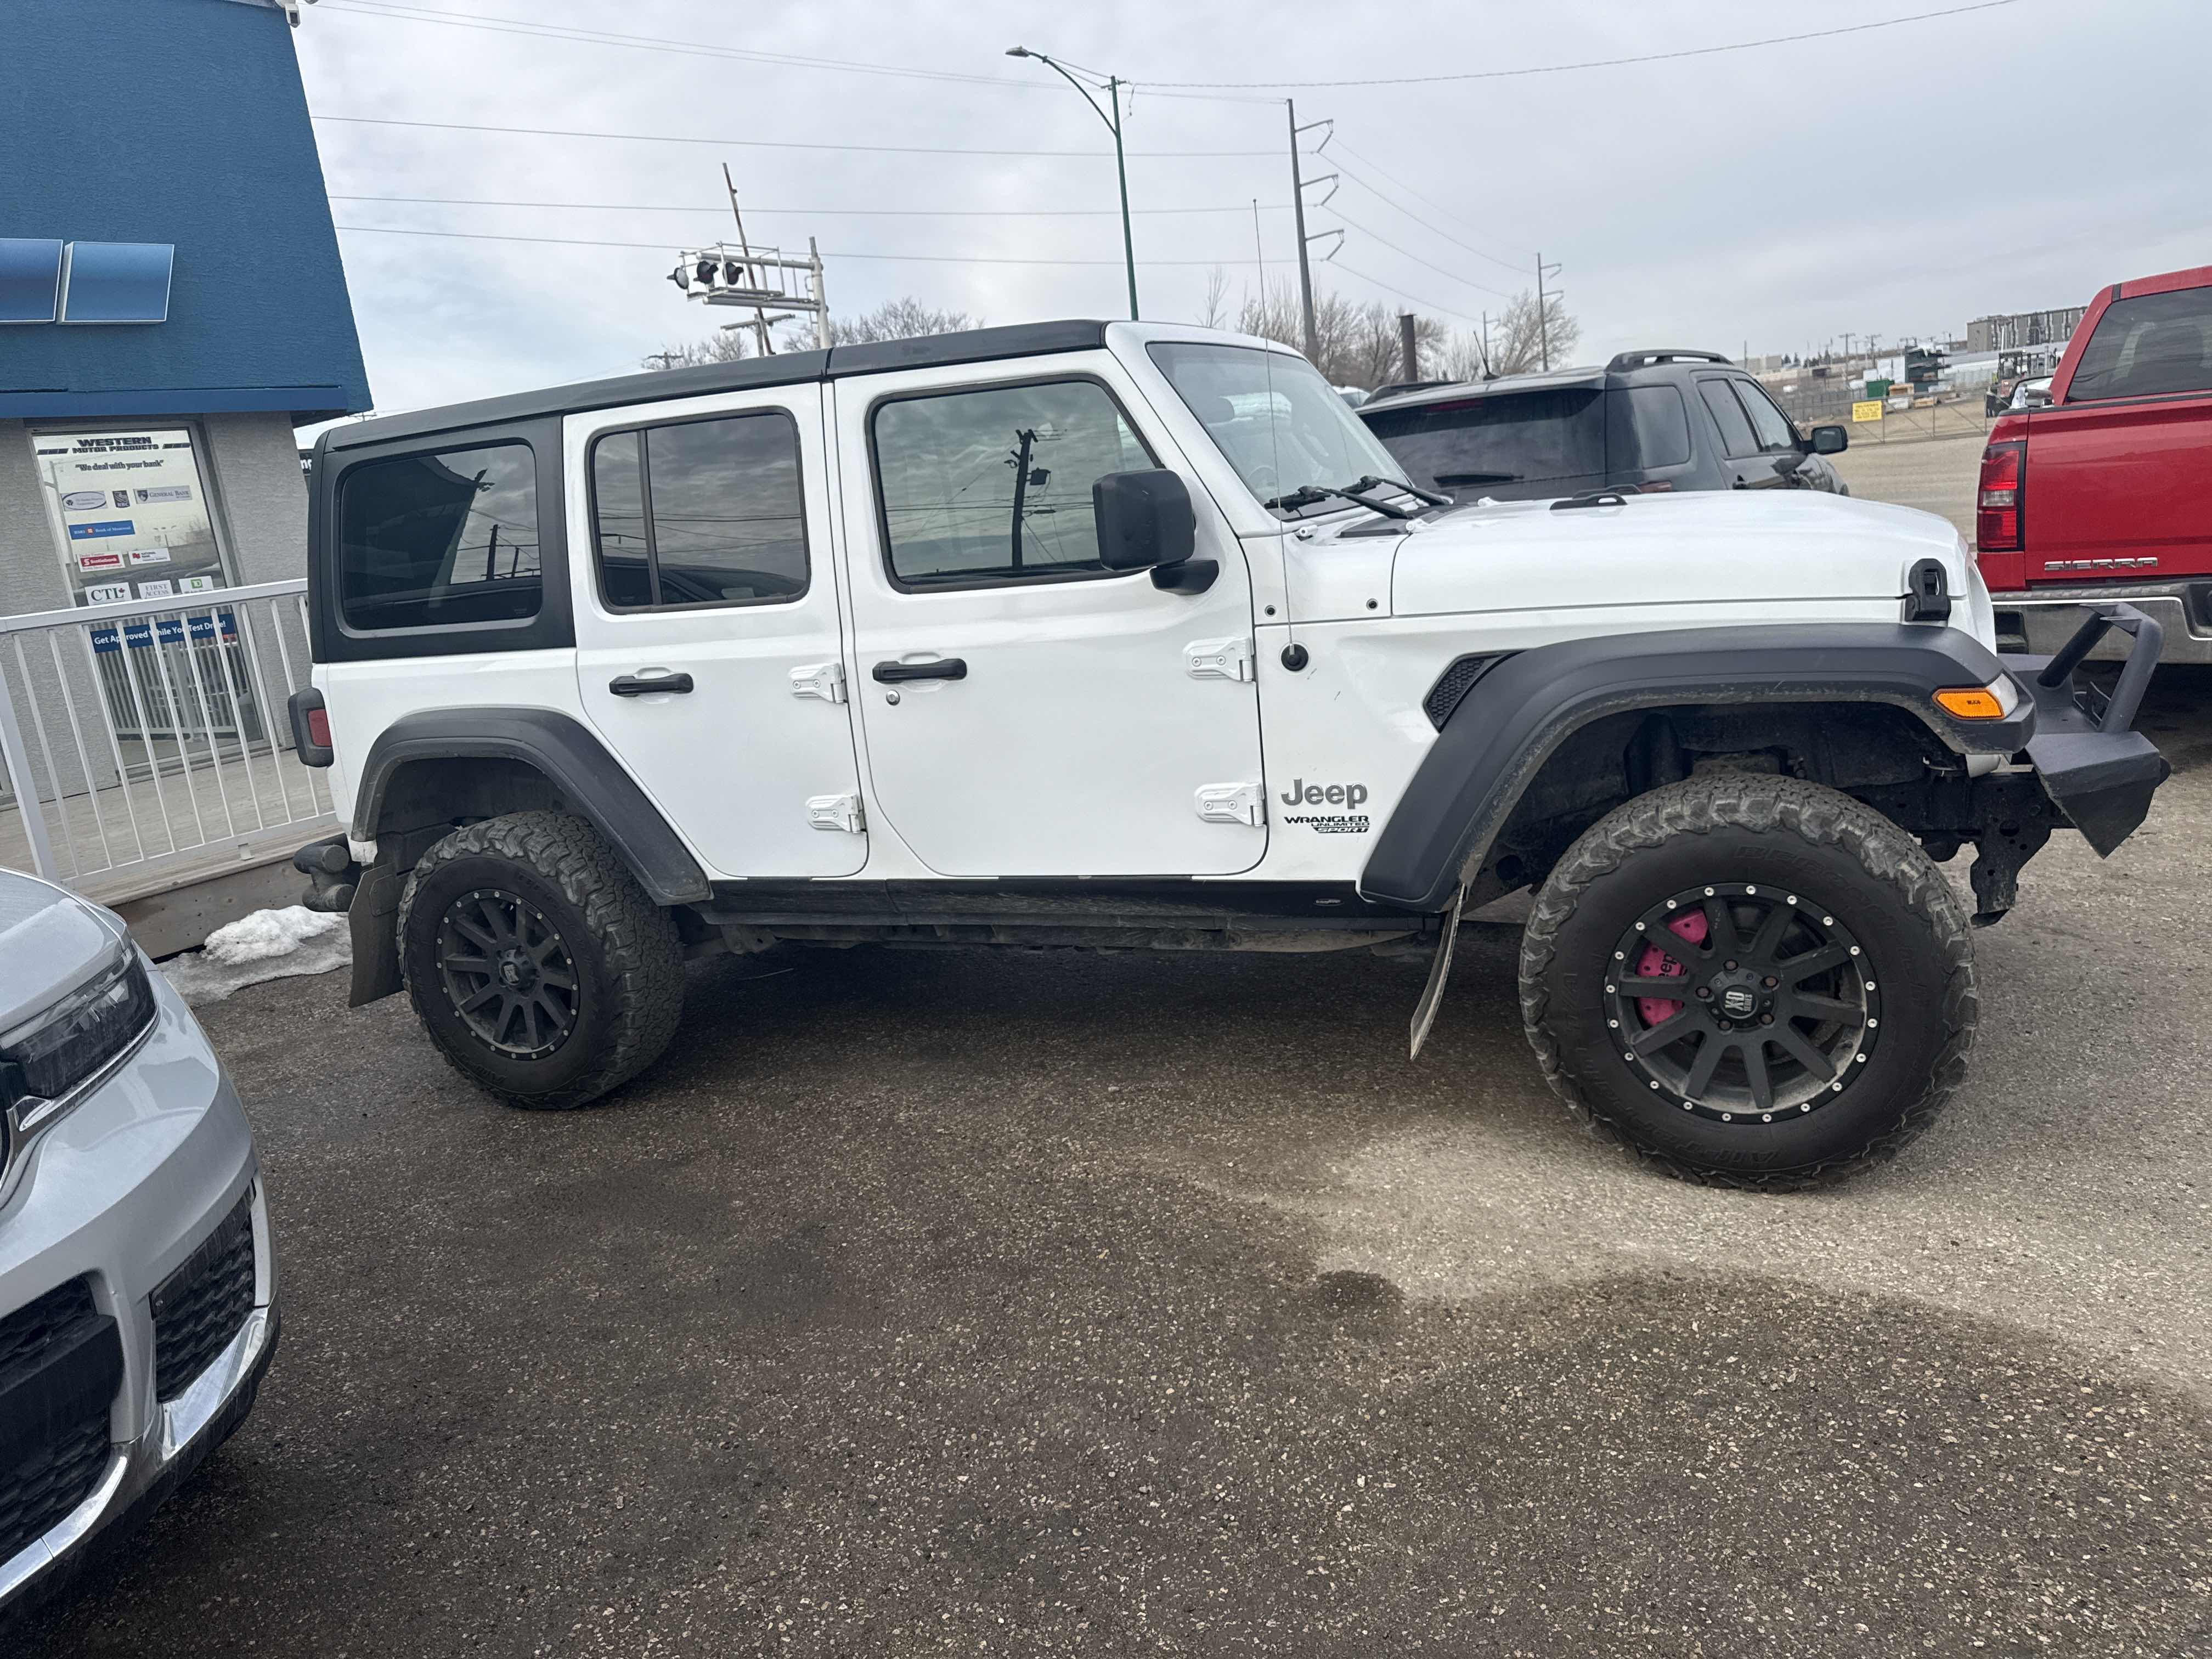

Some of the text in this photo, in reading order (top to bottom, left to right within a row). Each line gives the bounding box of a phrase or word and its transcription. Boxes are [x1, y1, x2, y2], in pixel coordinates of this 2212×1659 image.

[77, 437, 152, 447] WESTERN
[92, 462, 109, 470] deal
[109, 461, 126, 470] with
[126, 462, 143, 471] your
[2044, 556, 2158, 571] SIERRA
[91, 588, 124, 601] CTL
[94, 636, 110, 645] Get
[110, 630, 149, 644] Aproved
[149, 628, 171, 636] hile
[204, 620, 226, 630] Dre!
[1280, 777, 1368, 810] Jeep
[1284, 815, 1369, 824] WRANGLER
[1724, 991, 1745, 1011] XD
